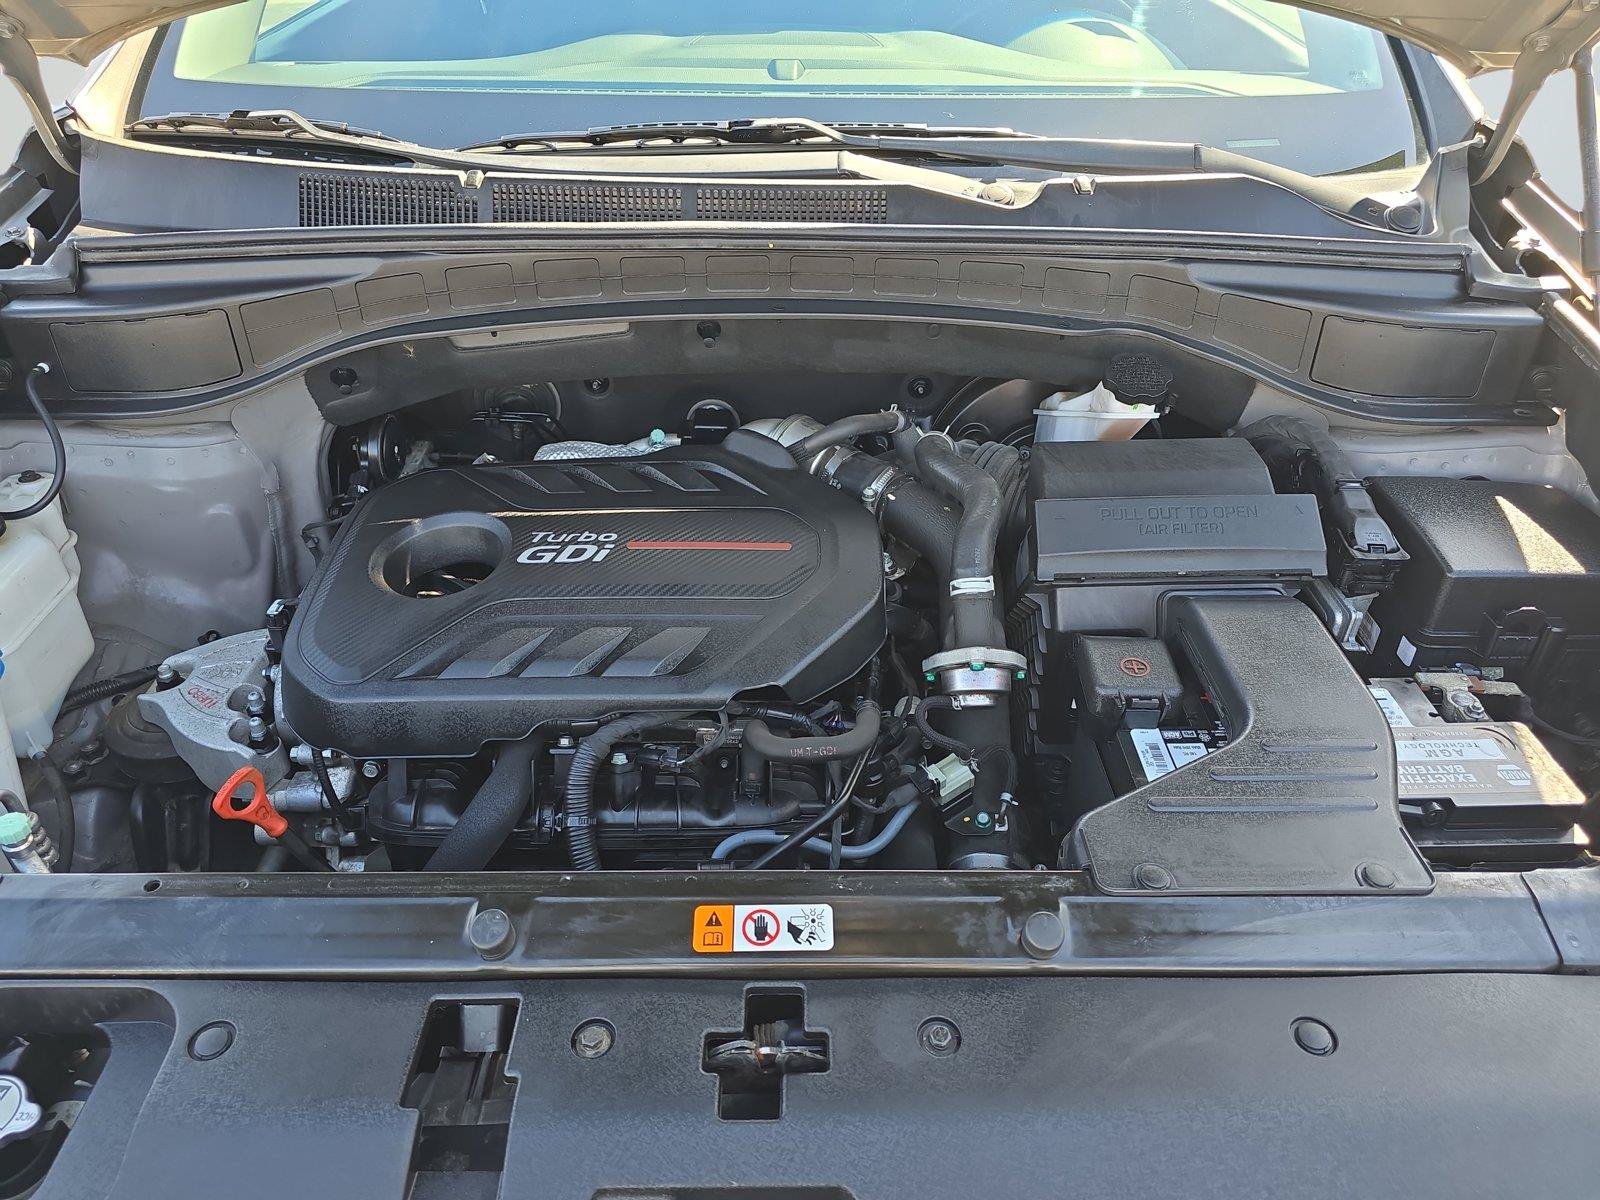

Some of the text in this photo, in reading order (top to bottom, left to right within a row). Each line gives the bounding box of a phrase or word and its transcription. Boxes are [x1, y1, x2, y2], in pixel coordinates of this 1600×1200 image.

[1100, 504, 1258, 521] PULL OUT TO OPEN
[1138, 522, 1224, 535] (AIR FILTER)
[531, 531, 618, 543] Turbo
[516, 544, 615, 564] GDi
[1425, 748, 1465, 758] AGM
[1399, 765, 1467, 774] BATTERY
[1499, 769, 1530, 781] NAPA
[1398, 773, 1477, 784] EXACT-FIT
